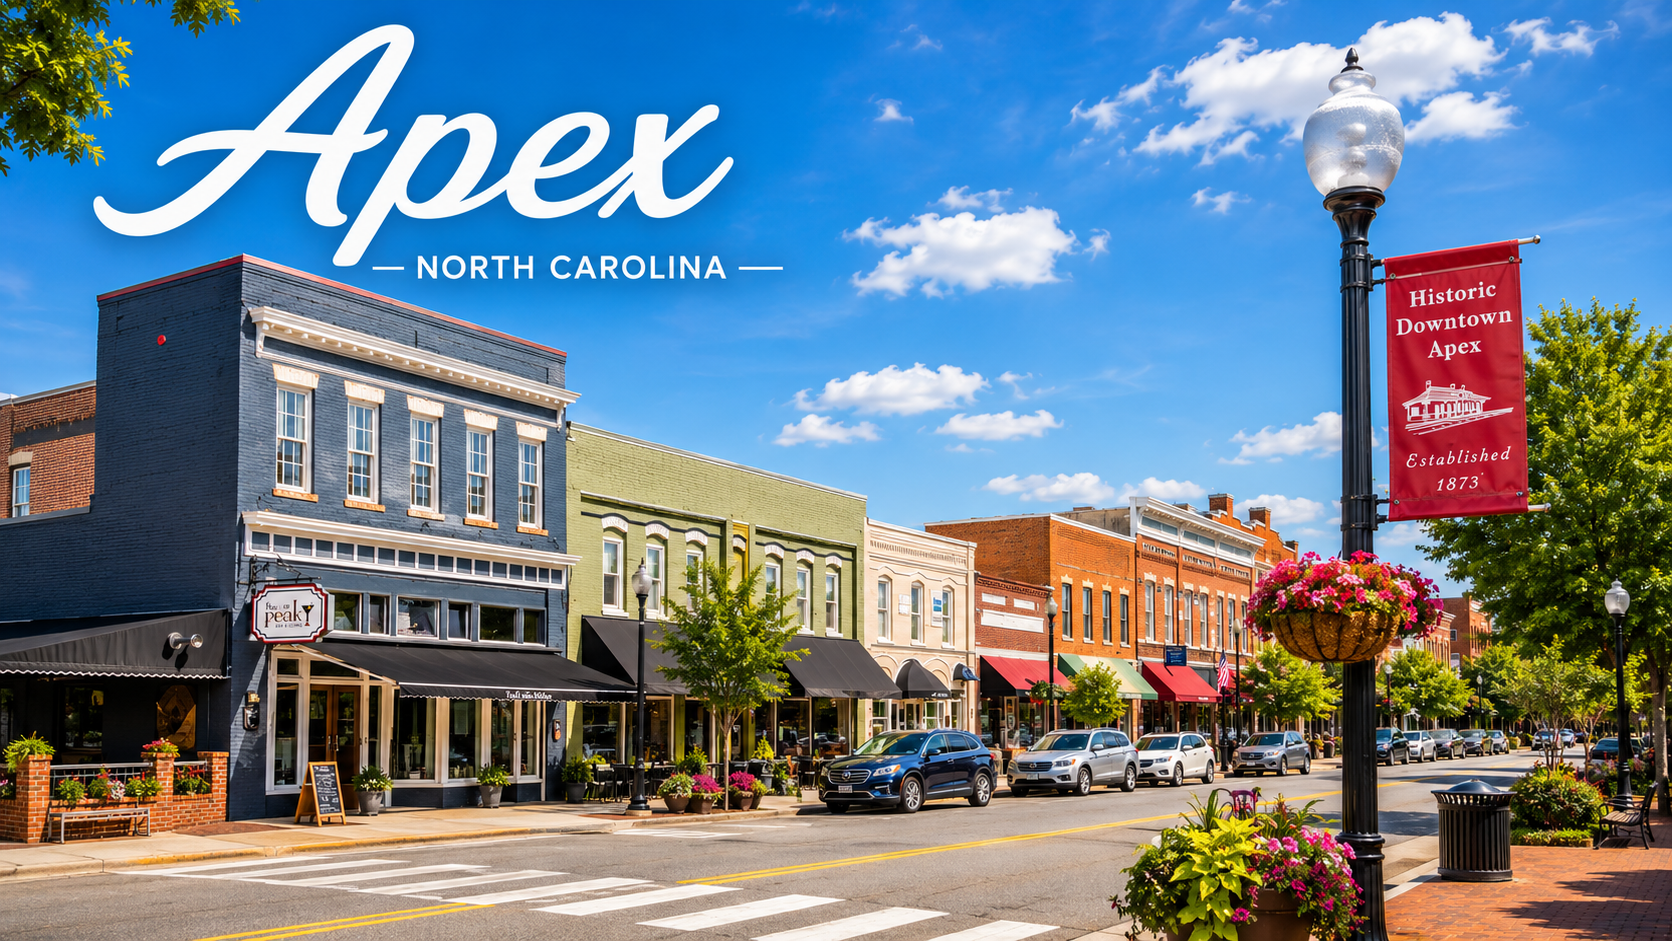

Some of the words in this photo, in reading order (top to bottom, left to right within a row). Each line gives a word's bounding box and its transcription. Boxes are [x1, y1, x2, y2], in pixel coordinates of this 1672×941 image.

[1409, 281, 1497, 308] Historic
[1396, 309, 1513, 336] Downtown
[1427, 340, 1482, 361] Apex
[1405, 445, 1512, 469] Established
[1436, 475, 1479, 492] 1873
